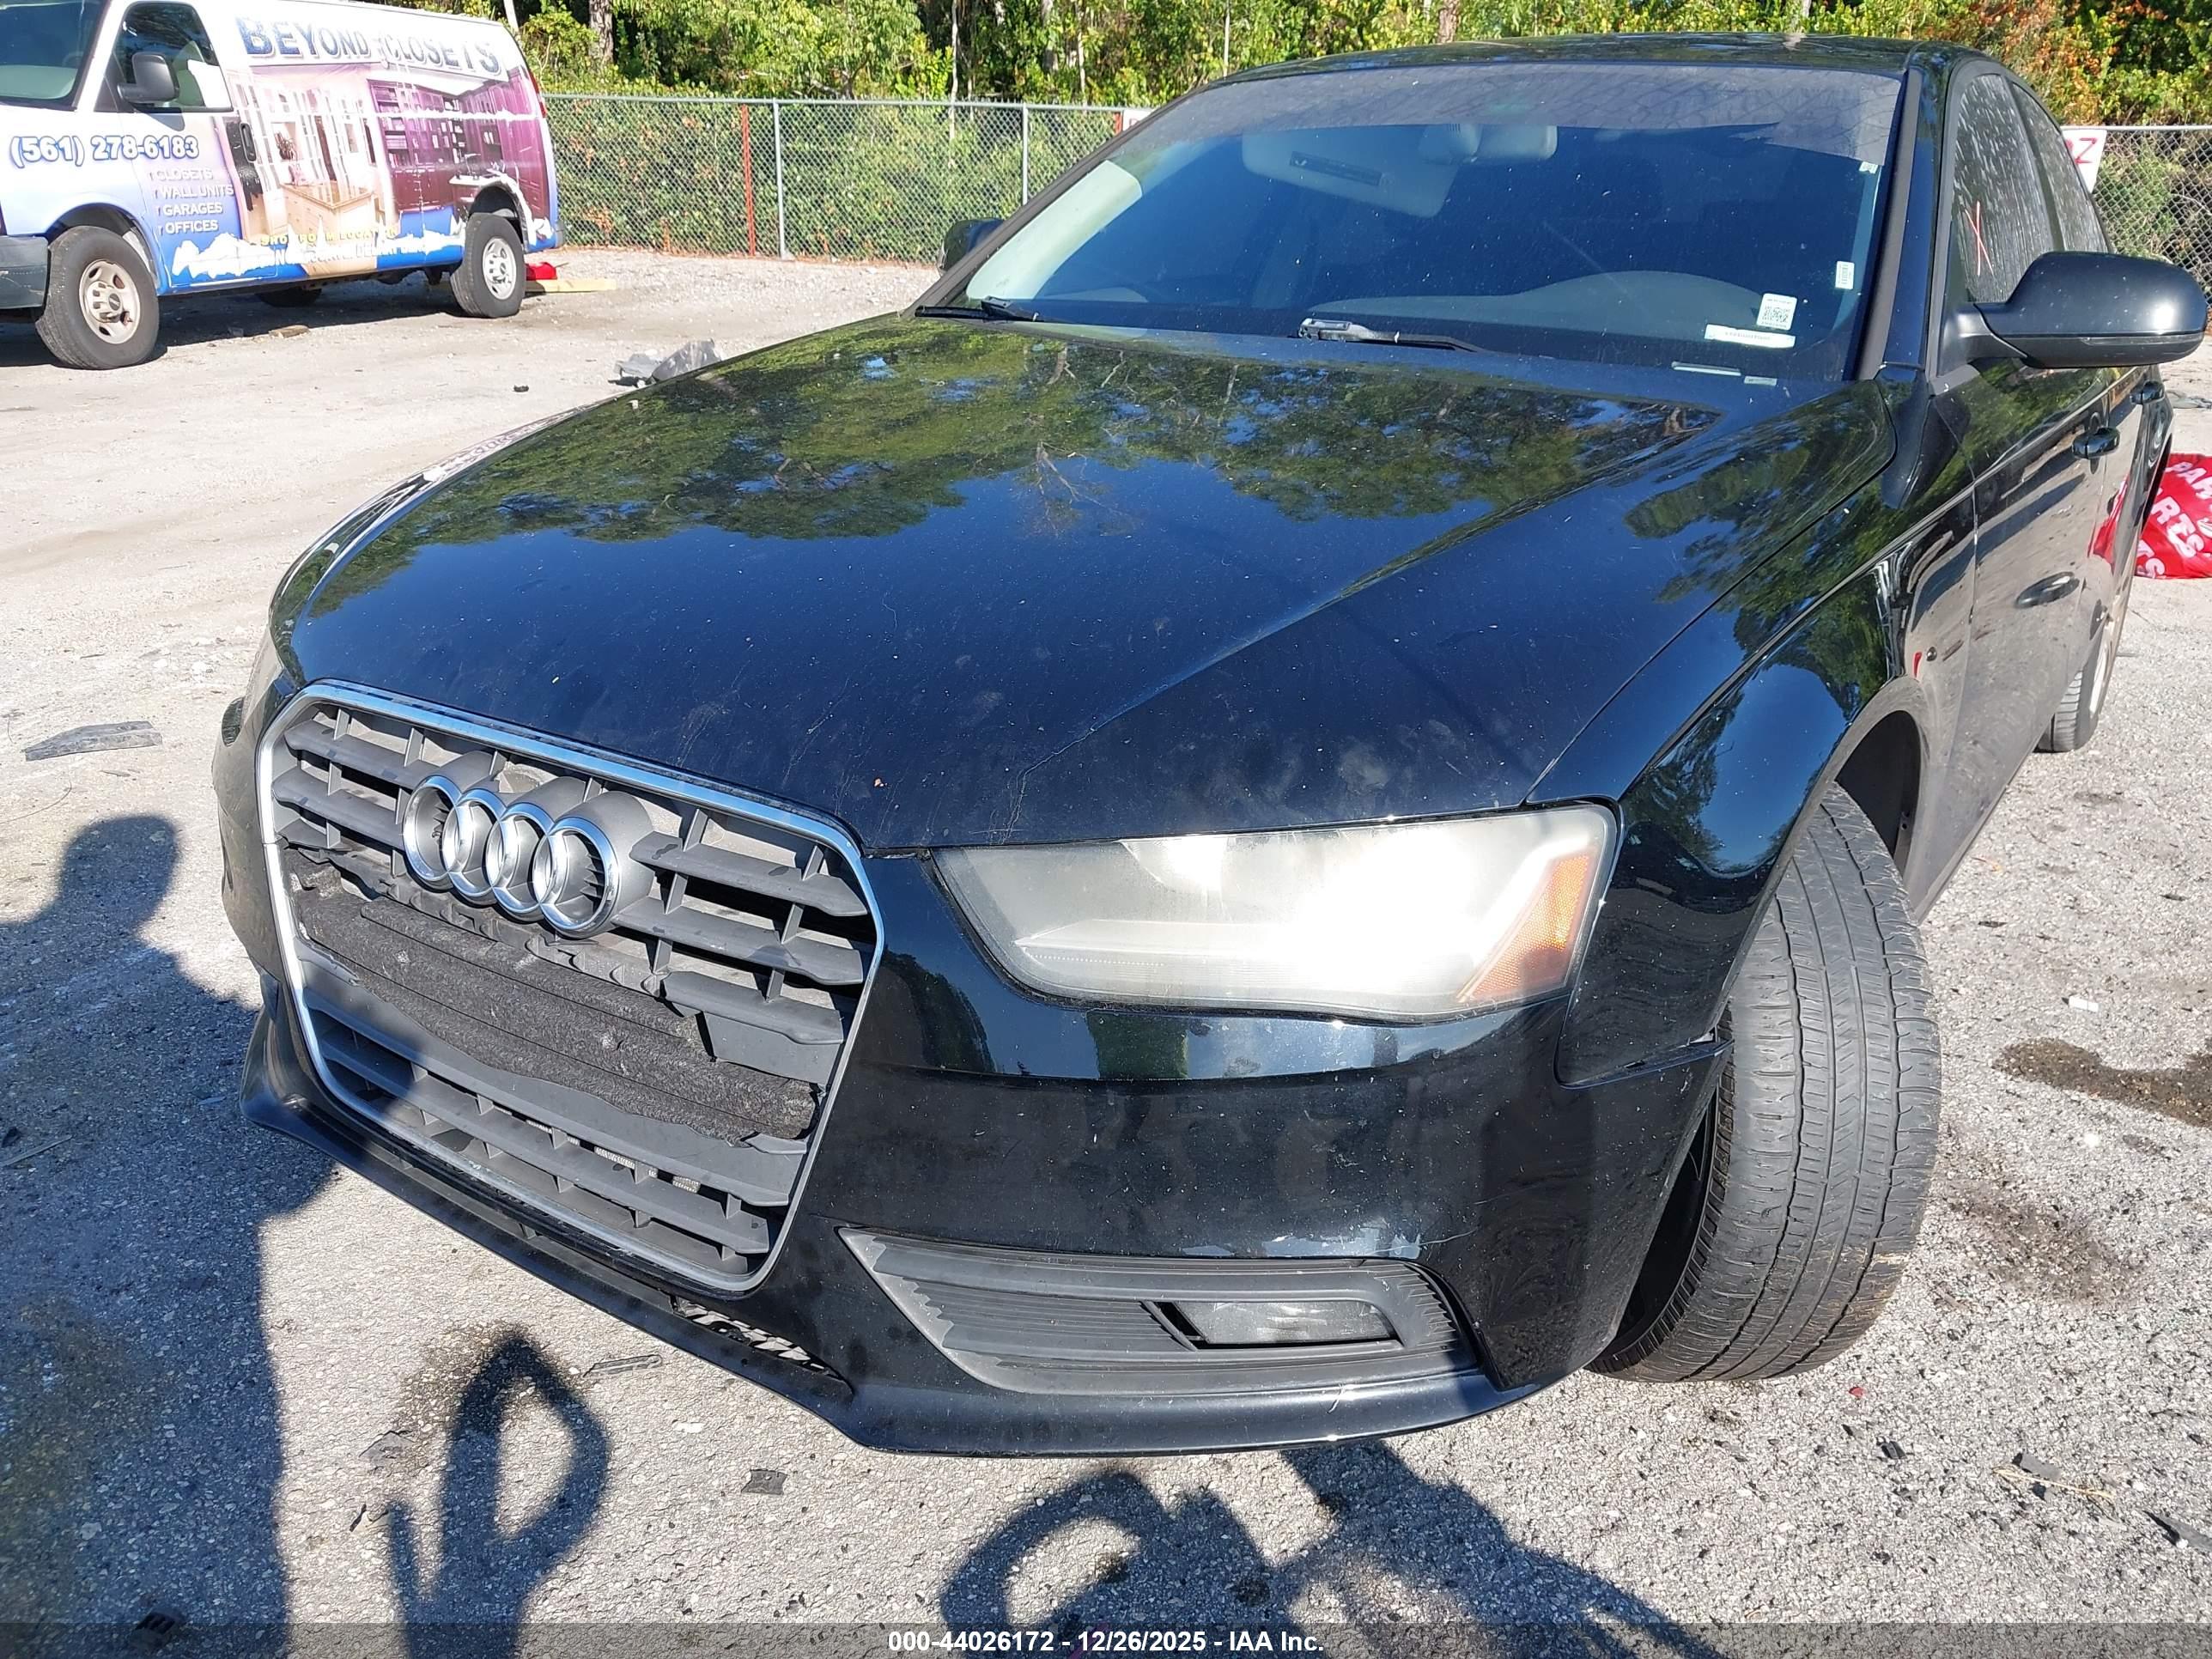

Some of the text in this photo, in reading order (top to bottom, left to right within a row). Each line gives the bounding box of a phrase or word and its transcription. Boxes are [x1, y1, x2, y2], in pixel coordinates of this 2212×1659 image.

[235, 16, 370, 58] BEYOND
[384, 33, 501, 76] CLOSETS
[10, 135, 199, 168] (561) 278-6183
[156, 167, 214, 180] CLOSETS
[160, 183, 234, 198] WALL UNITS
[163, 201, 224, 216] GARAGES
[165, 219, 220, 234] OFFICES
[260, 226, 397, 246] SHOROM LOCATN
